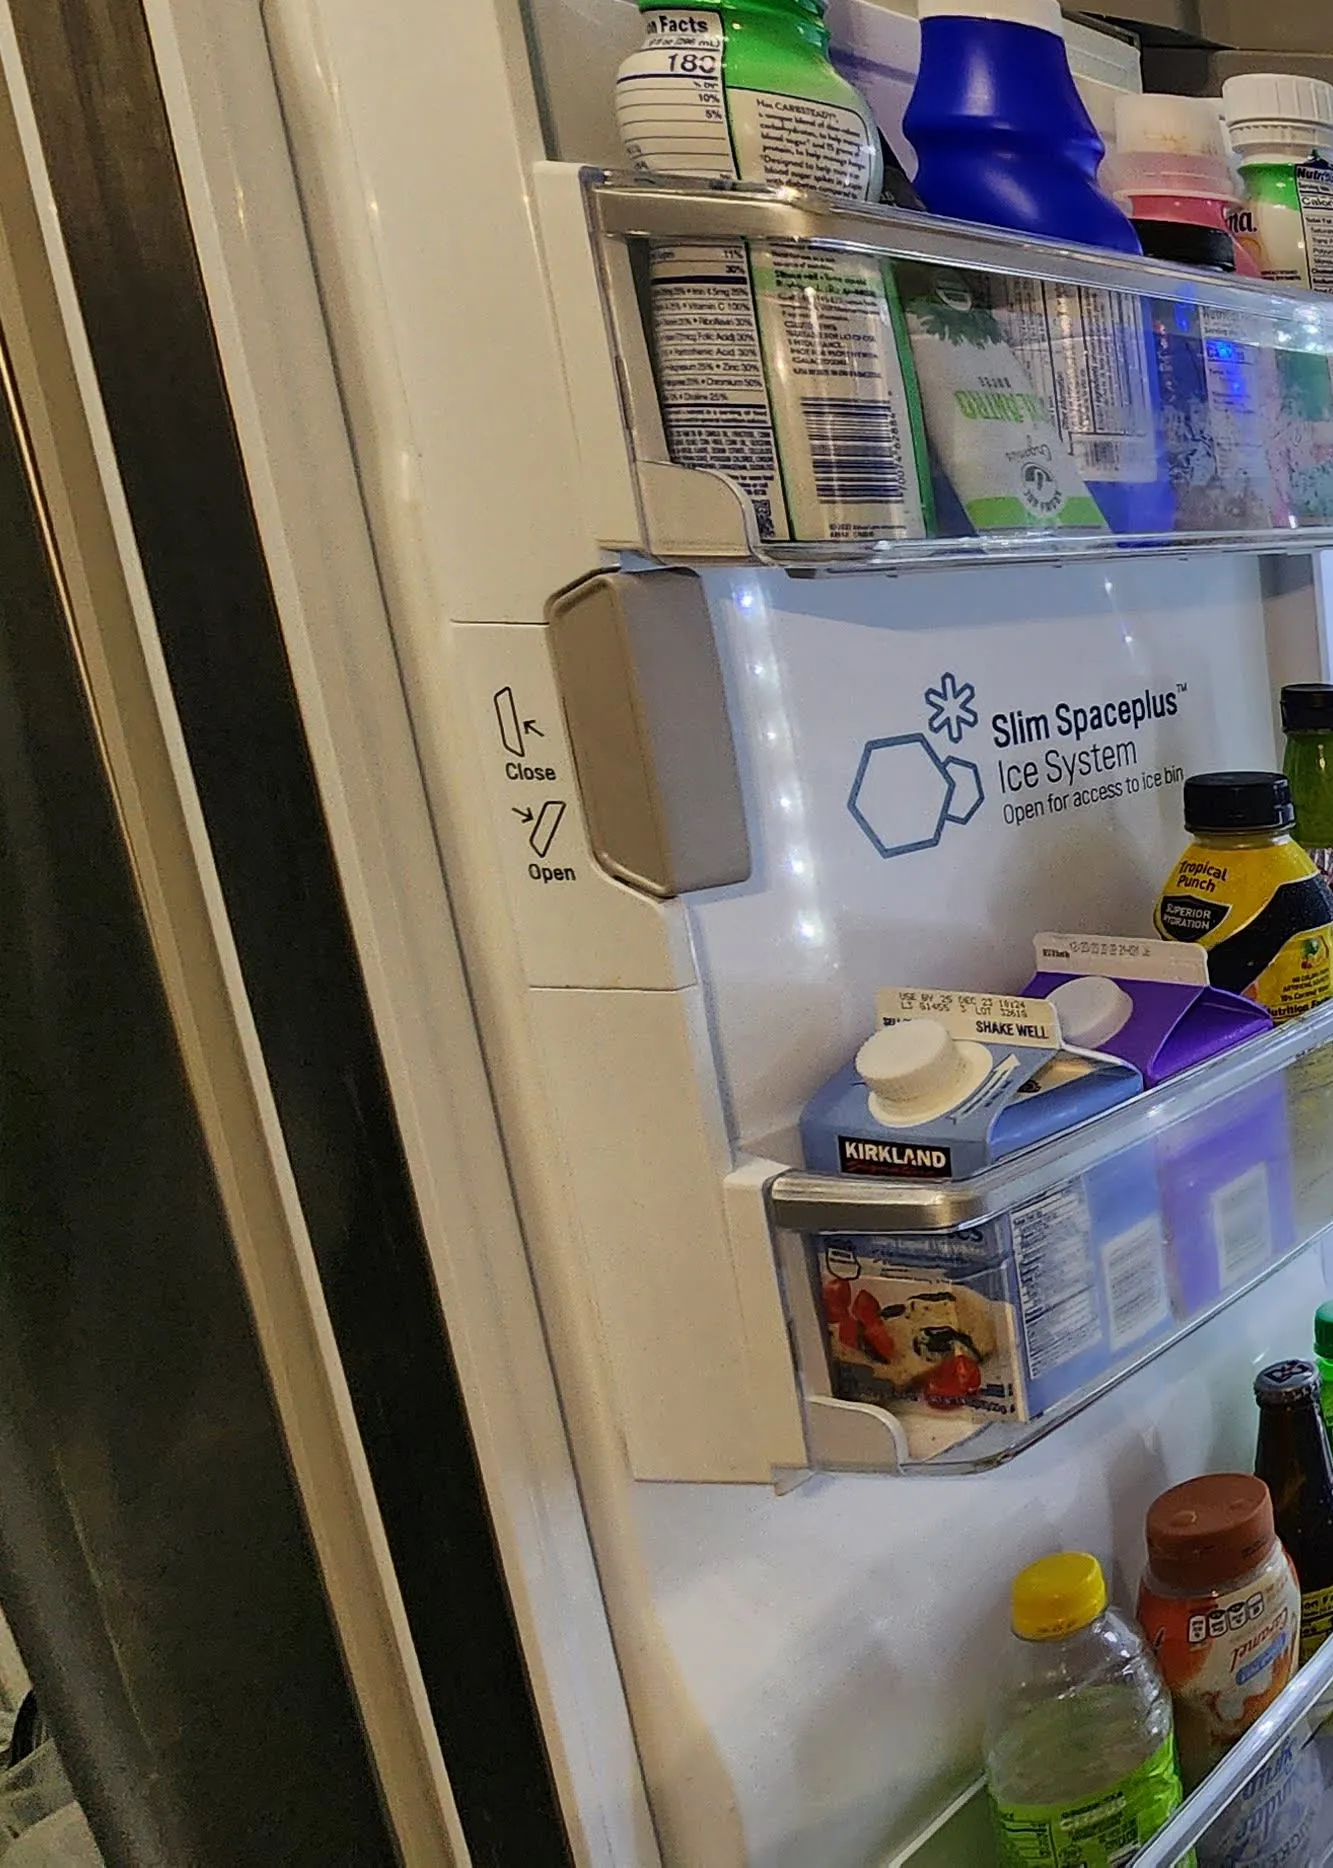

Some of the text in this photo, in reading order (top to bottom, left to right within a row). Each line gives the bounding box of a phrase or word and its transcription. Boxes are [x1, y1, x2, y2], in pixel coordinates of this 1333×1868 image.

[659, 15, 708, 33] Facts
[668, 53, 716, 74] 180
[705, 109, 722, 120] 5%
[717, 302, 725, 311] C
[991, 707, 1049, 748] Slim
[506, 763, 556, 784] Close
[998, 740, 1138, 794] Ice System
[1002, 766, 1185, 828] Open for access to ice bin
[528, 863, 576, 884] Open
[1179, 860, 1229, 882] Tropical
[1177, 874, 1217, 893] Punch
[899, 991, 917, 1001] USE
[975, 1006, 992, 1016] LOT
[976, 1020, 1049, 1040] SHAKE WELL
[844, 1141, 947, 1168] KIRKLAND
